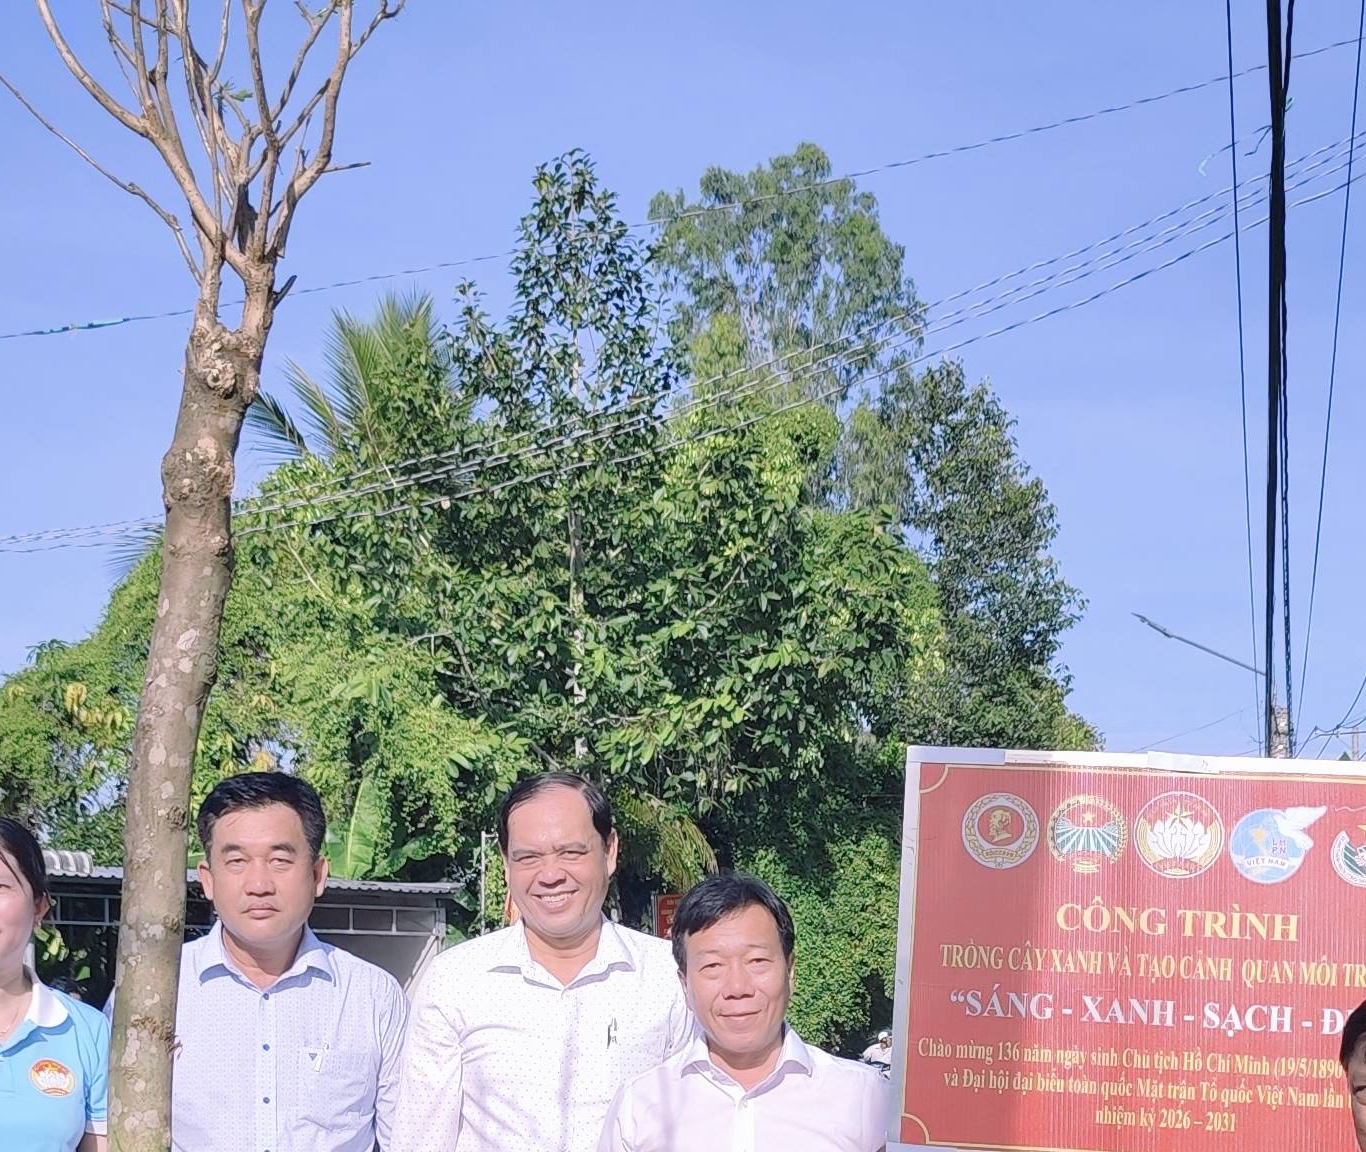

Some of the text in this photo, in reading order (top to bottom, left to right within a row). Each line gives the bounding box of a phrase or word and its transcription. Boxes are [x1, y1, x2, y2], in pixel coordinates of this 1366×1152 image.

[1055, 895, 1300, 942] CÔNG TRÌNH
[1007, 940, 1047, 972] CÂY
[1050, 948, 1102, 975] XANH
[1107, 945, 1132, 977] VÀ
[1138, 953, 1176, 983] TẠO
[1179, 951, 1233, 982] CẢNH
[1241, 958, 1295, 988] QUAN
[1299, 954, 1338, 987] MÔI
[1080, 994, 1176, 1028] XANH
[1202, 1001, 1293, 1038] SẠCH
[918, 1037, 952, 1058] Chào
[955, 1040, 994, 1065] mừng
[998, 1041, 1020, 1061] 136
[1023, 1043, 1052, 1063] năm
[1056, 1045, 1088, 1070] ngày
[1090, 1047, 1118, 1067] sinh
[1122, 1048, 1150, 1068] Chủ
[1154, 1049, 1179, 1074] tịch
[1182, 1046, 1203, 1072] Hồ
[1206, 1052, 1231, 1073] Chí
[1234, 1053, 1270, 1075] Minh
[943, 1068, 959, 1086] và
[962, 1069, 985, 1093] Đại
[988, 1070, 1009, 1094] hội
[1012, 1071, 1034, 1096] đại
[1037, 1068, 1065, 1093] biểu
[1068, 1073, 1097, 1095] toàn
[1101, 1072, 1133, 1100] quốc
[1137, 1078, 1164, 1103] Mặt
[1168, 1079, 1196, 1104] trận
[1199, 1076, 1218, 1102] Tổ
[1220, 1078, 1253, 1107] quốc
[1257, 1083, 1284, 1110] Việt
[1287, 1086, 1319, 1108] Nam
[1322, 1081, 1344, 1109] lần
[1095, 1105, 1136, 1129] nhiệm
[1159, 1108, 1191, 1130] 2026
[1205, 1111, 1236, 1132] 2031
